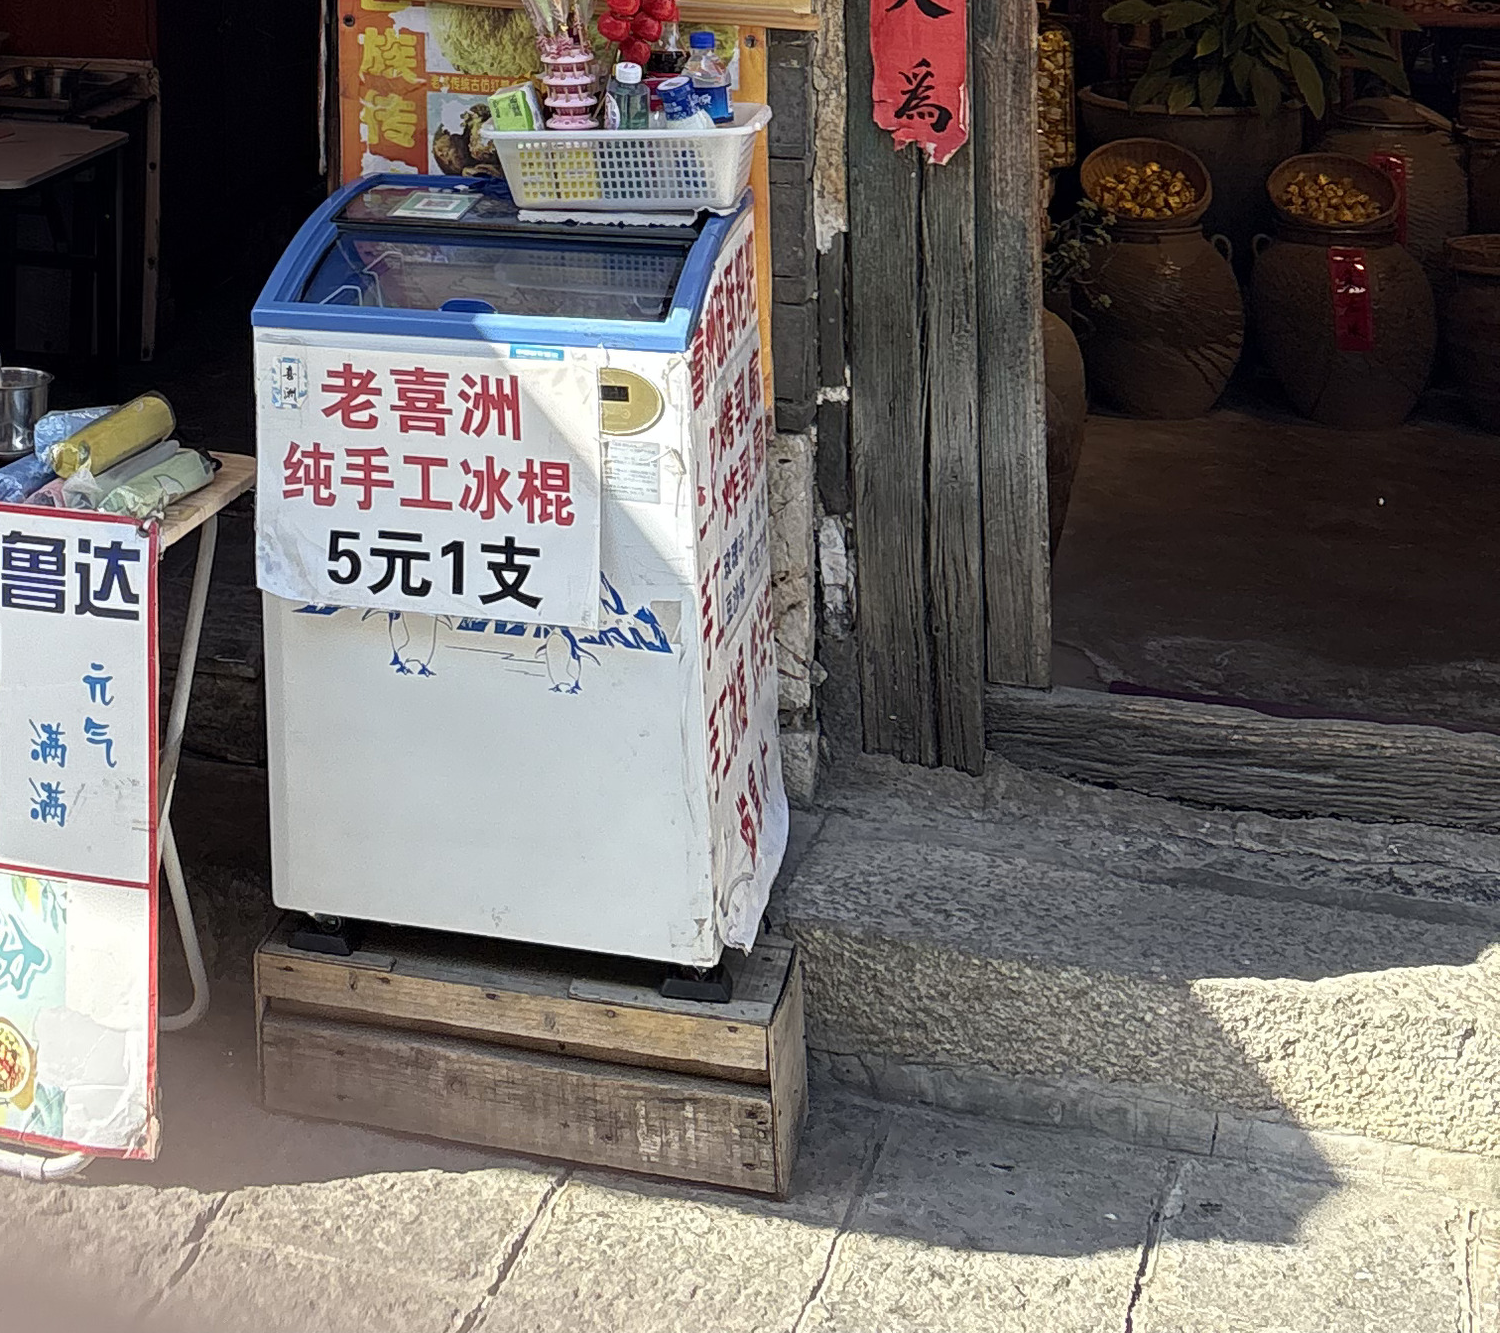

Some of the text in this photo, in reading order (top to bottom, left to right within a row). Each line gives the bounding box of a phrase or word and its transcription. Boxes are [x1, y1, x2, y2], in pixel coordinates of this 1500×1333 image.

[319, 362, 523, 442] 老喜洲
[281, 441, 577, 528] 纯手工冰棍
[326, 529, 545, 610] 5元1支
[81, 663, 118, 768] 元气
[28, 718, 67, 828] 满满
